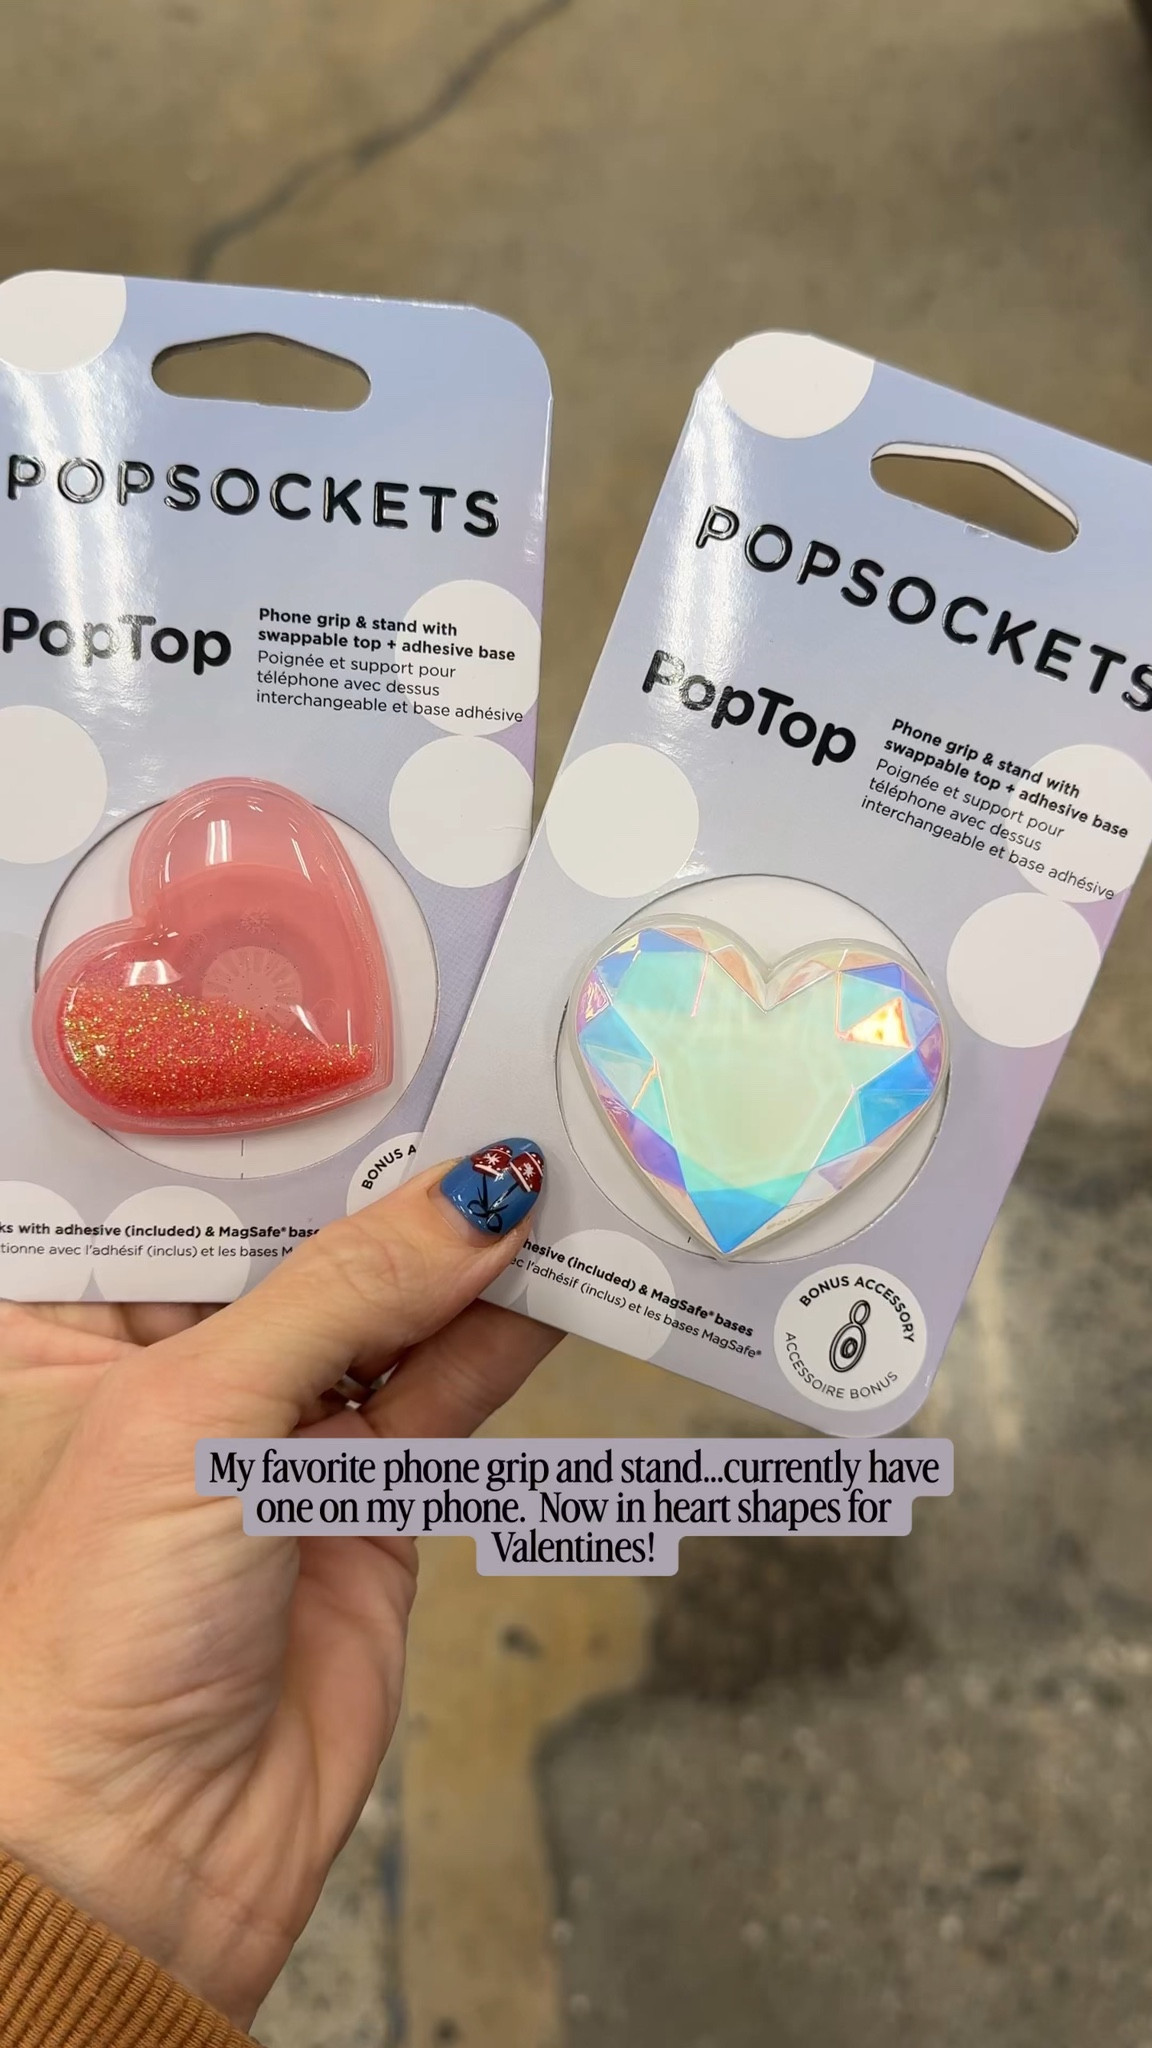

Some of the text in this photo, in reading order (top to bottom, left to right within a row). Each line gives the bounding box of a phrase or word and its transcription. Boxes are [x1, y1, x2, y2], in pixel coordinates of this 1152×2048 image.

[8, 454, 500, 537] POPSOCKETS
[2, 607, 232, 675] PopTop
[259, 608, 457, 636] Phone grip & stand with
[695, 505, 1152, 712] POPSOCKETS
[258, 629, 515, 661] swappable top + adhesive base
[258, 651, 456, 678] Poignée et support pour
[256, 690, 523, 722] interchangeable et base adhésive
[257, 670, 440, 696] téléphone avec dessus
[641, 649, 856, 767] PopTop
[884, 739, 1128, 838] swappable top + adhesive base
[891, 718, 1080, 799] Phone grip & stand with
[869, 777, 1042, 851] téléphone avec dessus
[876, 758, 1065, 838] Poignée et support pour
[861, 795, 1115, 900] interchangeable et base adhésive
[361, 1148, 404, 1190] BONUS
[18, 1223, 50, 1235] with
[55, 1224, 121, 1236] adhesive
[125, 1225, 201, 1238] (included)
[205, 1226, 215, 1237] &
[288, 1226, 320, 1238] bas
[49, 1246, 81, 1256] avec
[85, 1244, 144, 1256] l'adhésif
[147, 1245, 197, 1258] (inclus)
[201, 1247, 214, 1257] et
[218, 1246, 236, 1257] les
[240, 1246, 278, 1257] bases
[526, 1260, 579, 1289] l'adhésif
[580, 1282, 627, 1309] (inclus)
[628, 1302, 642, 1314] et
[643, 1306, 661, 1322] les
[663, 1314, 700, 1336] bases
[567, 1256, 636, 1292] (included)
[638, 1284, 648, 1296] &
[714, 1313, 754, 1337] bases
[799, 1276, 915, 1343] BONUS ACCESSORY
[785, 1332, 898, 1399] ACCESSOIRE BONUS
